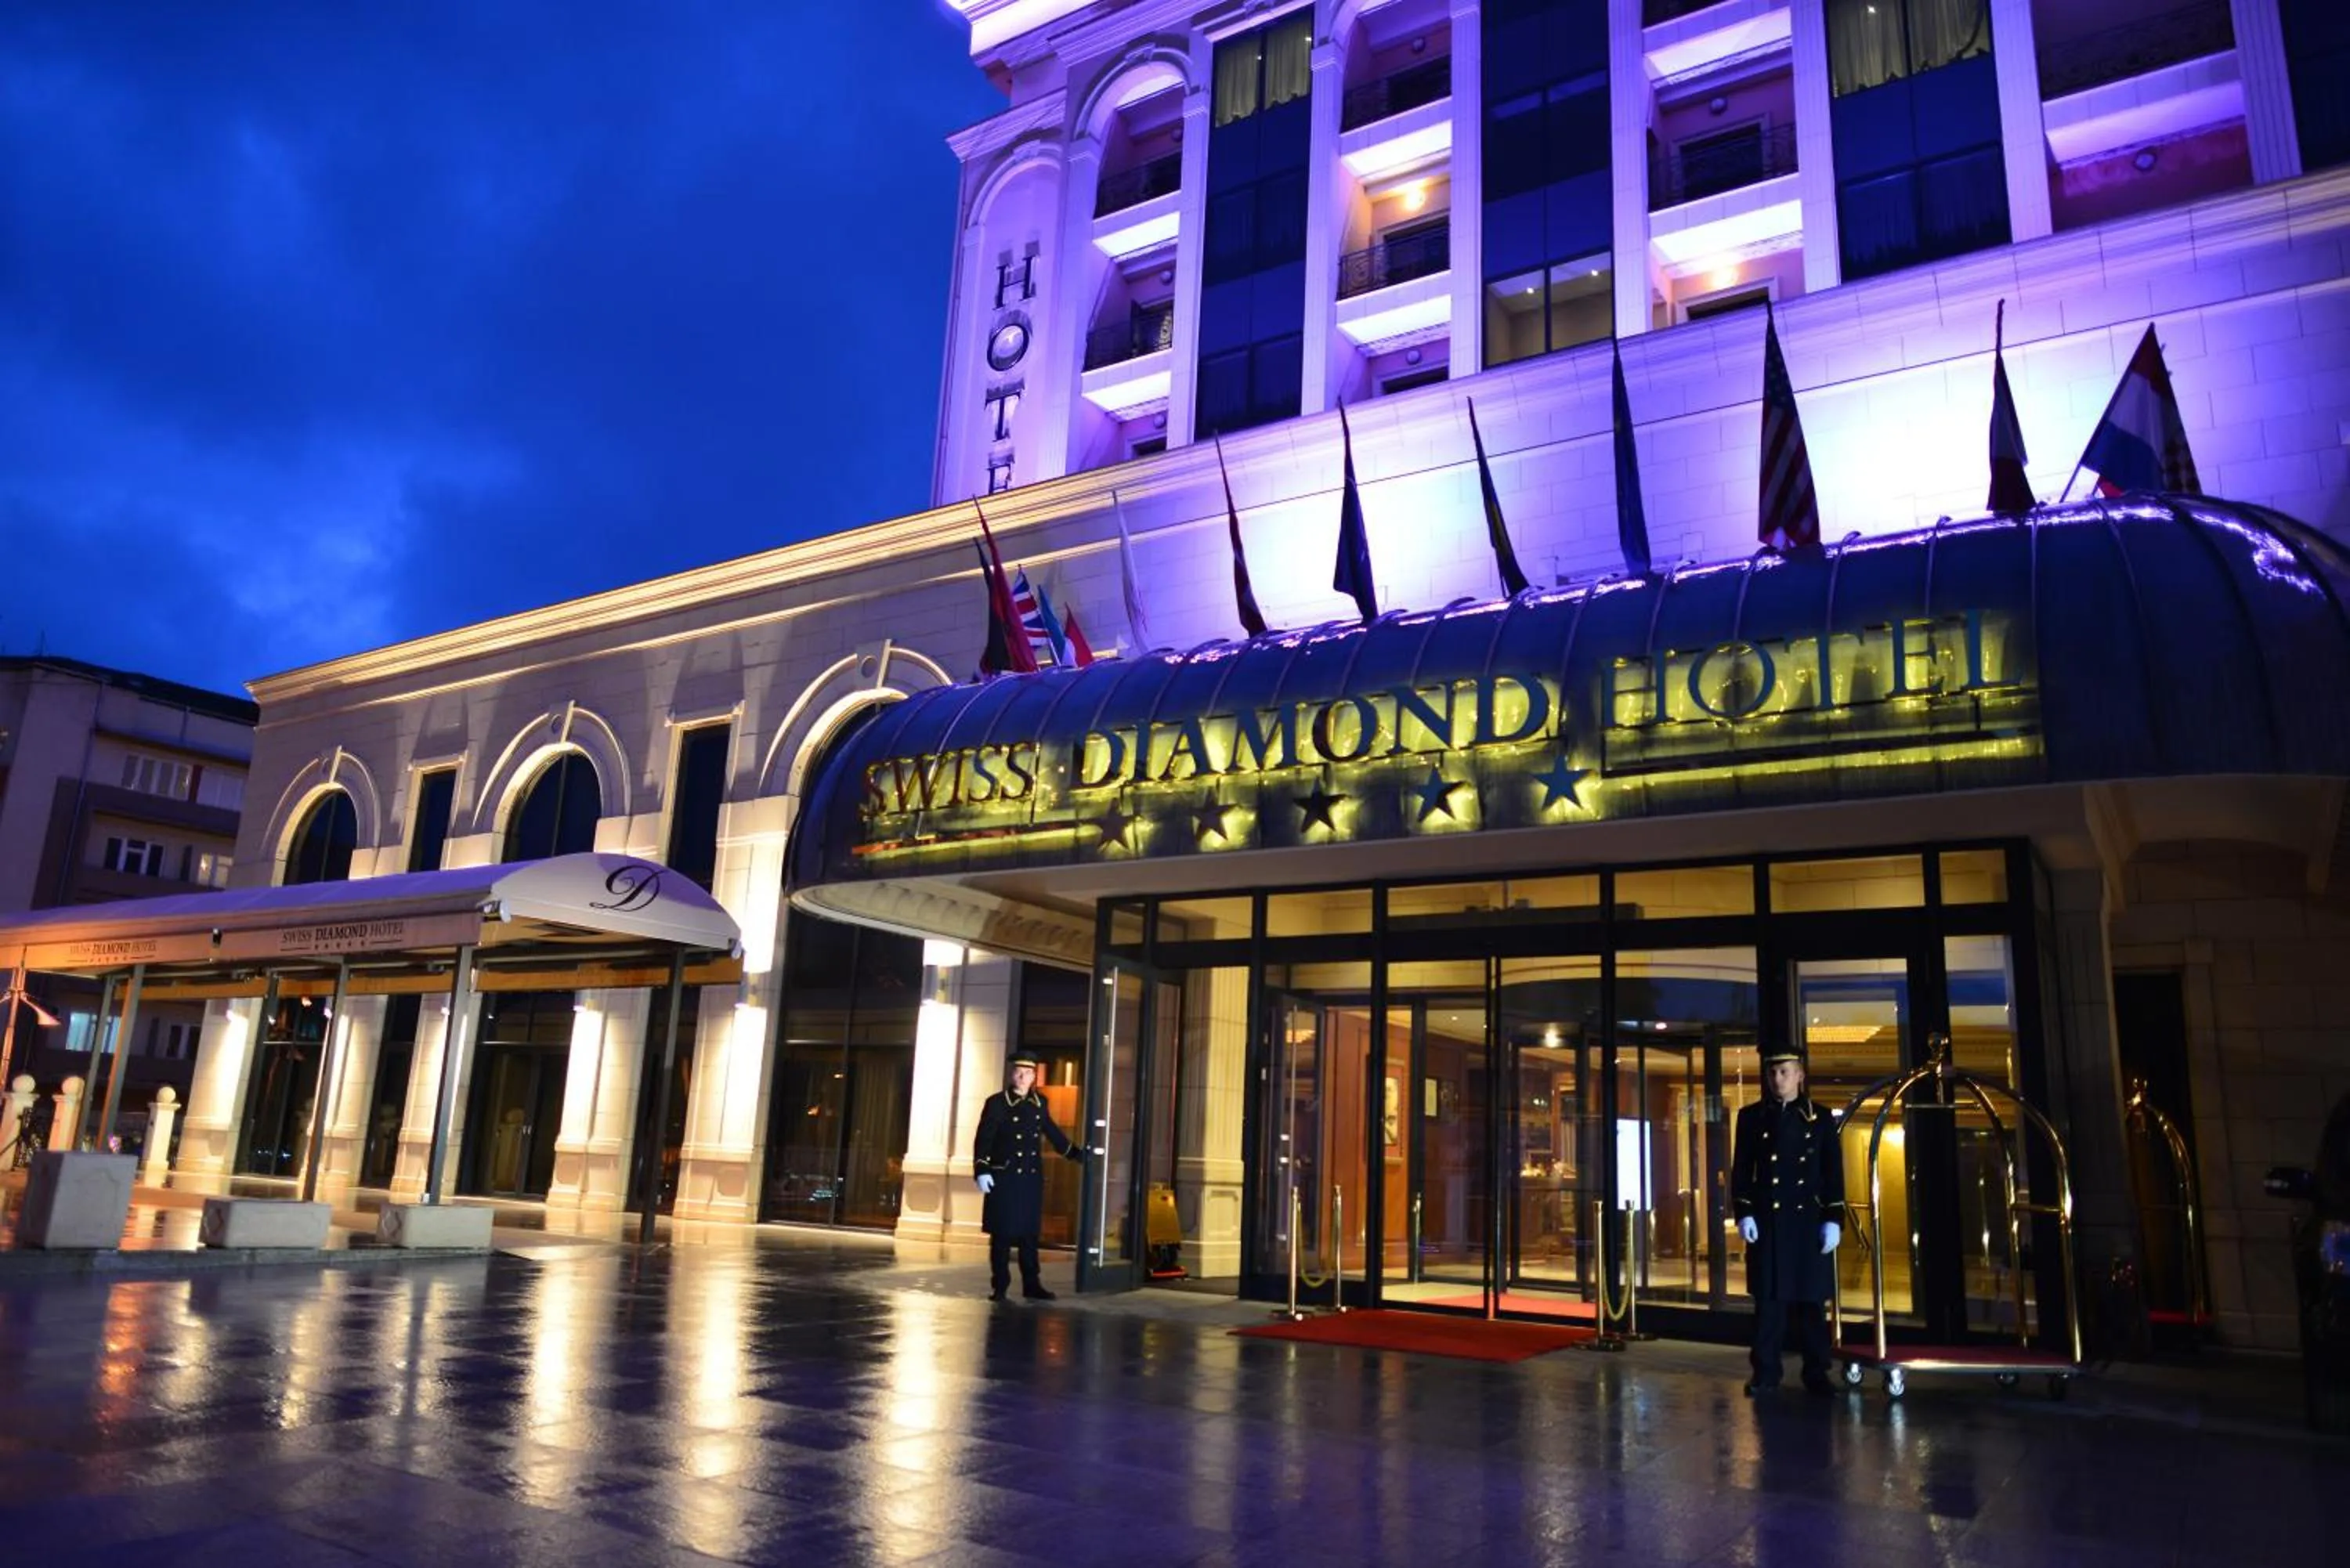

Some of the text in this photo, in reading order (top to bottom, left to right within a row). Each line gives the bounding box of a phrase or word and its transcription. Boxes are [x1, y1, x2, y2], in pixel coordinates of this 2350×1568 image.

[863, 609, 2024, 816] SWISS DIAMOND HOTEL
[282, 921, 404, 943] SWISS DIAMOND HOTEL
